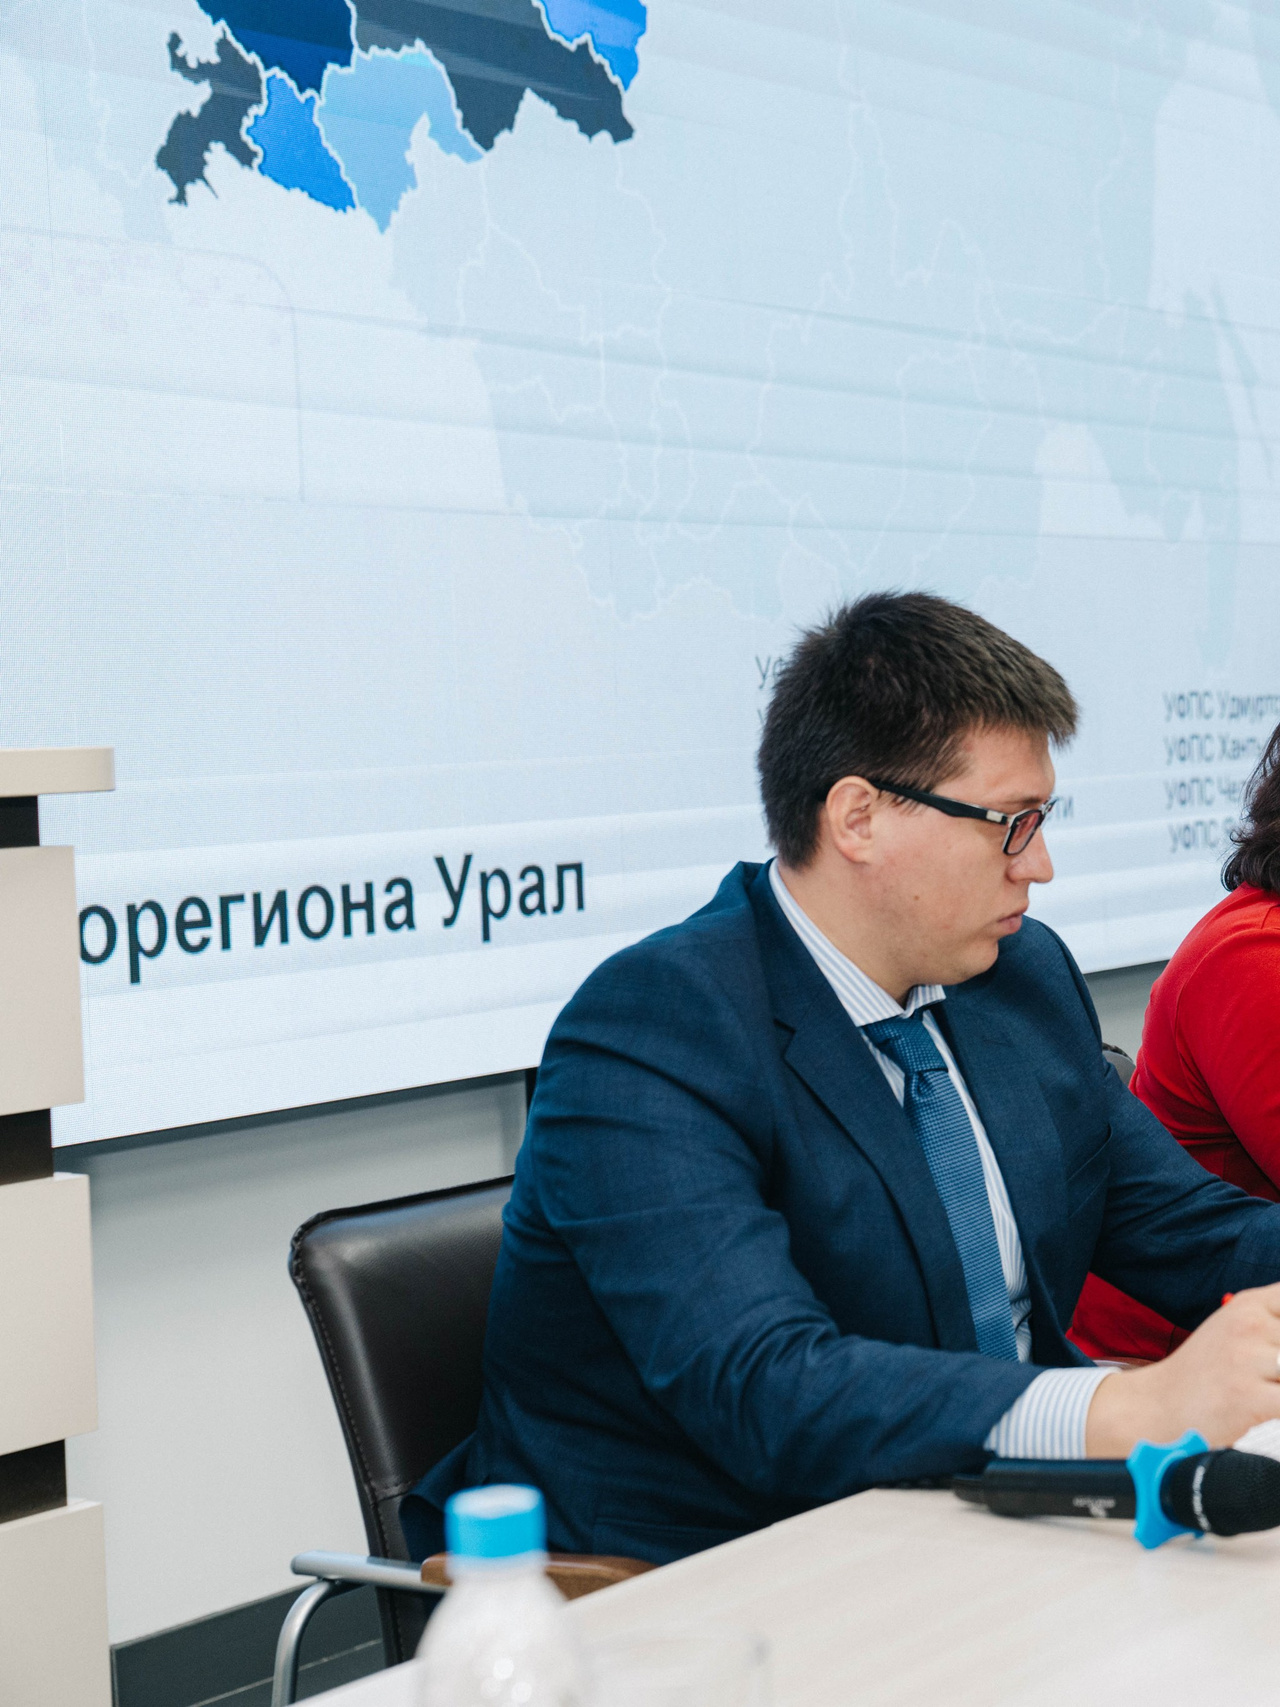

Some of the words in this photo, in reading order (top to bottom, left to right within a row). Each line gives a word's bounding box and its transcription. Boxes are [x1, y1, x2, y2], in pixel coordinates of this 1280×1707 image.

[1163, 691, 1213, 722] УФПС
[1163, 734, 1214, 765] УФПС
[1164, 777, 1214, 810] УФПС
[435, 853, 586, 942] Урал
